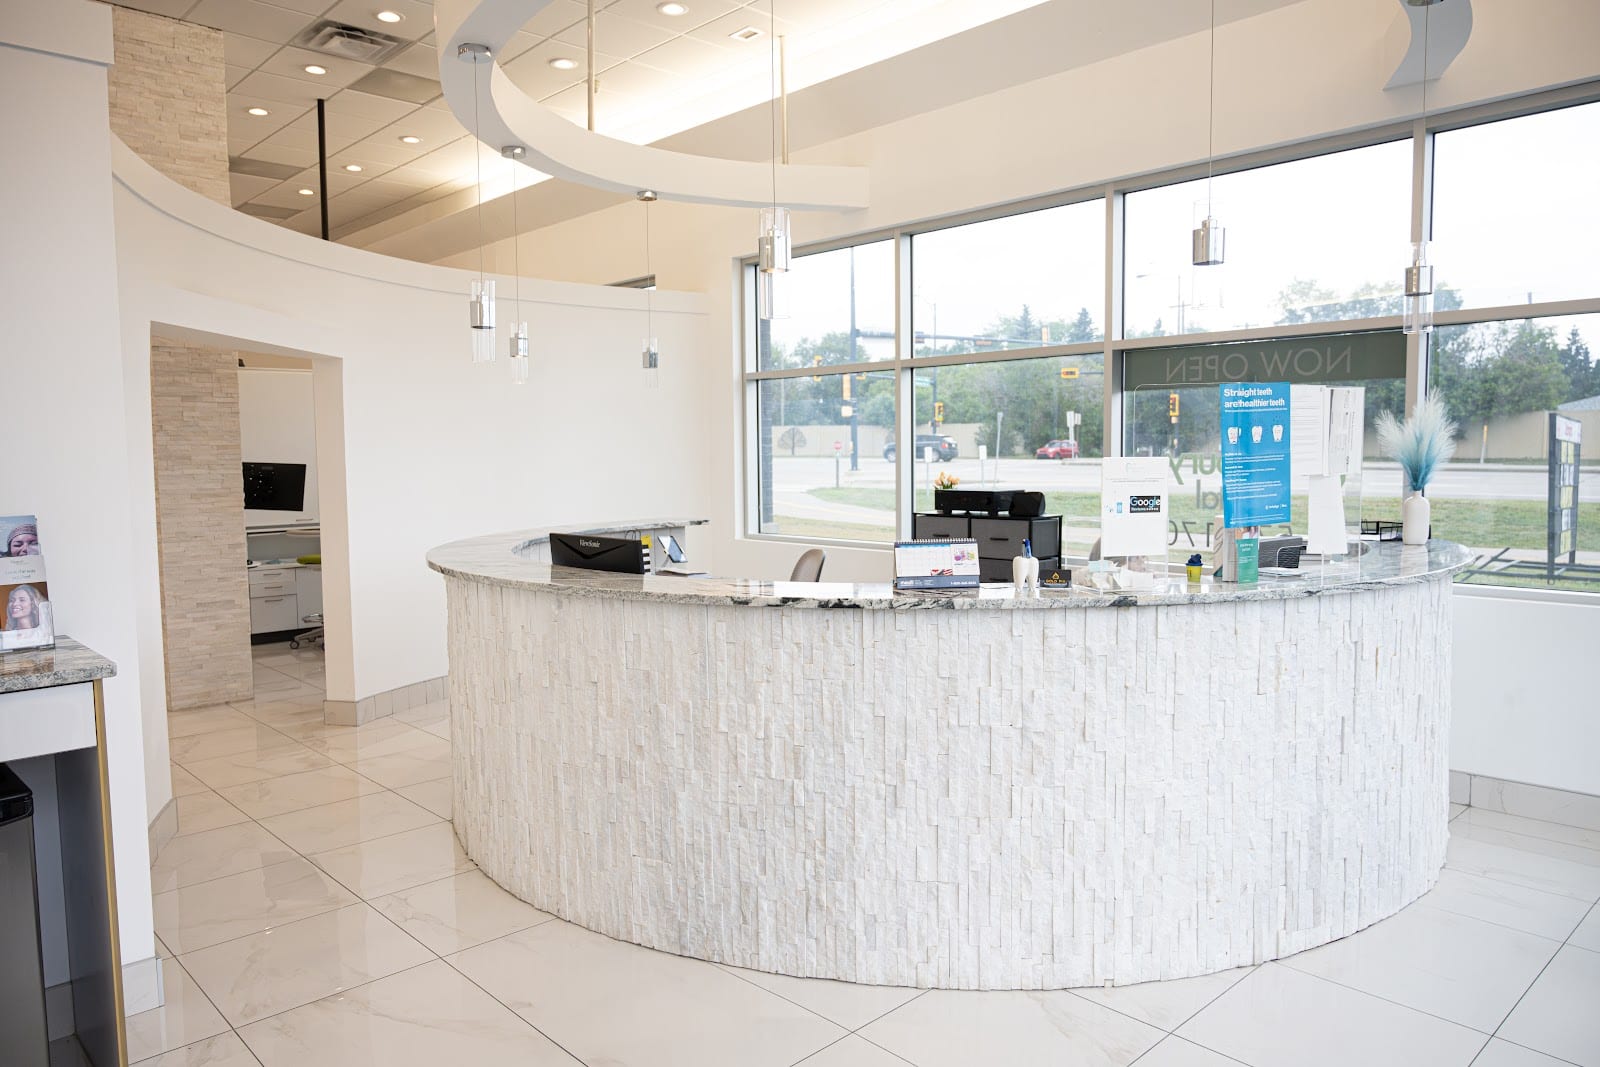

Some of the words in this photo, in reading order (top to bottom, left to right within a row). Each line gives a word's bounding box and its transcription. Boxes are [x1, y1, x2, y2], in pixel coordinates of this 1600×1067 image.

[1224, 388, 1256, 397] Straight
[1257, 387, 1273, 396] teeth
[1270, 397, 1285, 406] teeth
[1130, 496, 1160, 508] Google
